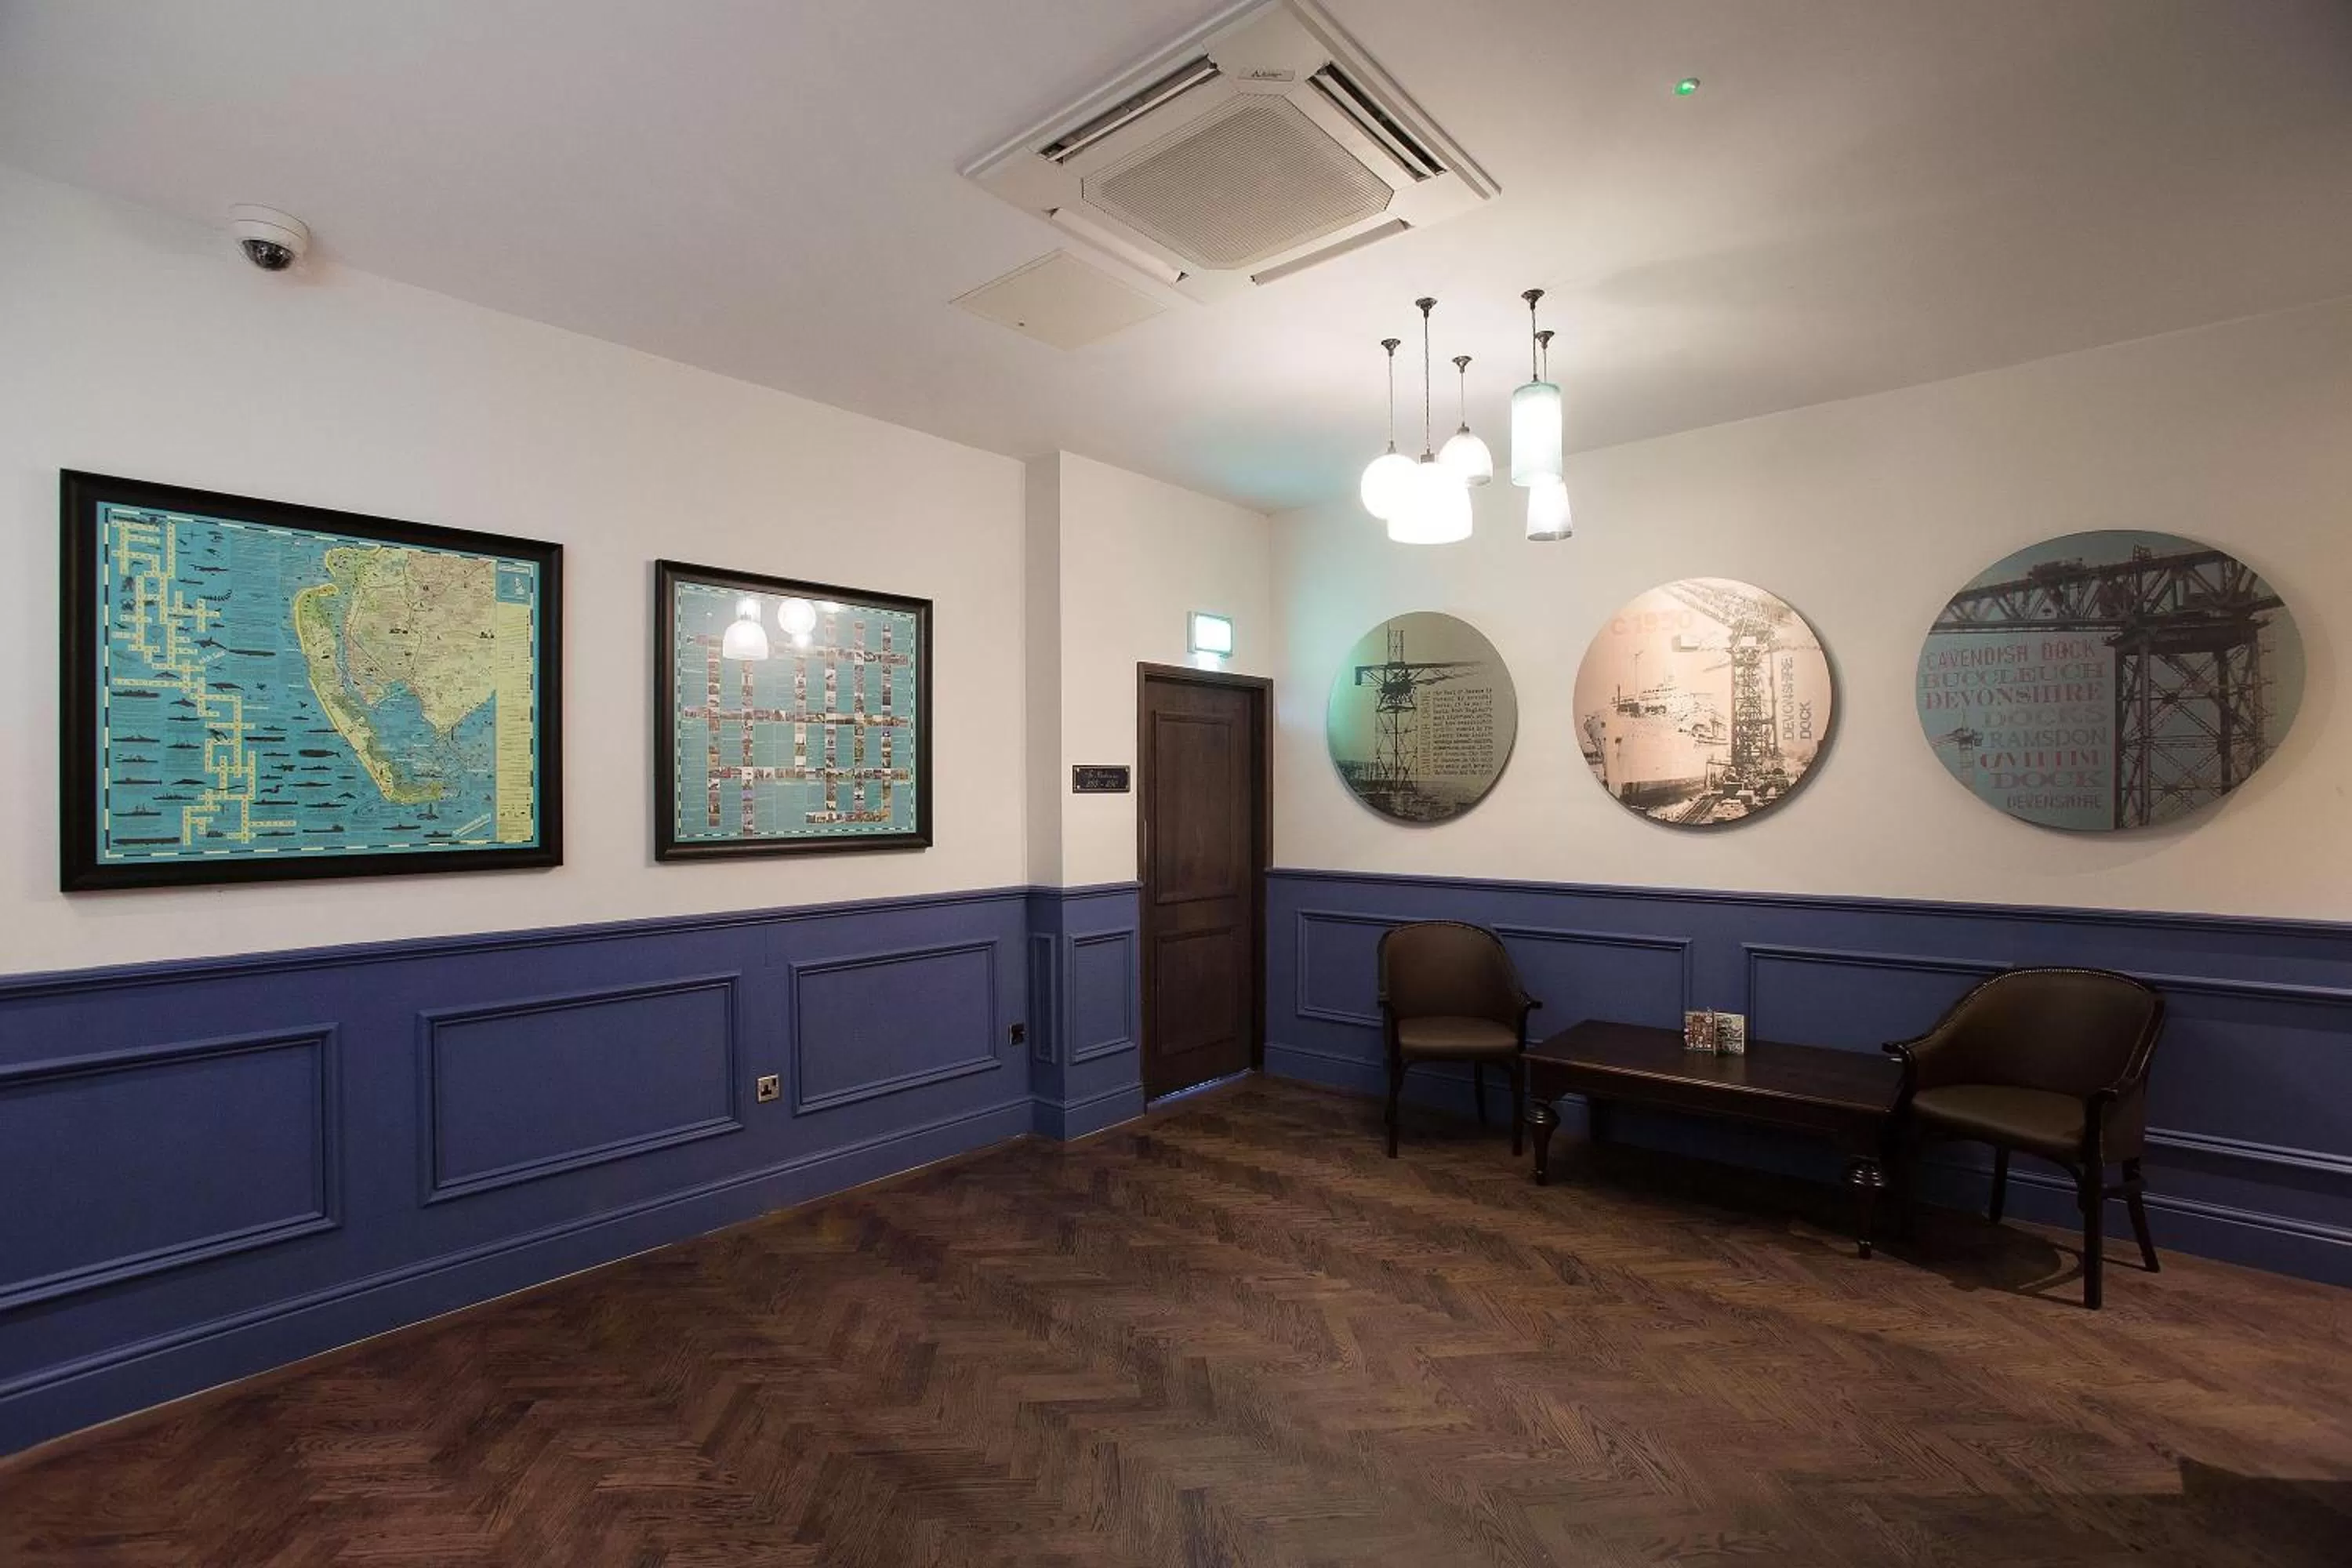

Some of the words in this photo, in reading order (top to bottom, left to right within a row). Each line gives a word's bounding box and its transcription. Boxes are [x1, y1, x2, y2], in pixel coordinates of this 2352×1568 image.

[1926, 644, 2028, 669] CAVENDISH
[2042, 639, 2095, 659] DOCK
[1922, 663, 2105, 688] BUCCLEUCH
[1926, 684, 2101, 709] DEVONSHIRE
[1799, 701, 1813, 740] DOCK
[1984, 707, 2107, 728] DOCKS
[1992, 772, 2105, 789] DOCK
